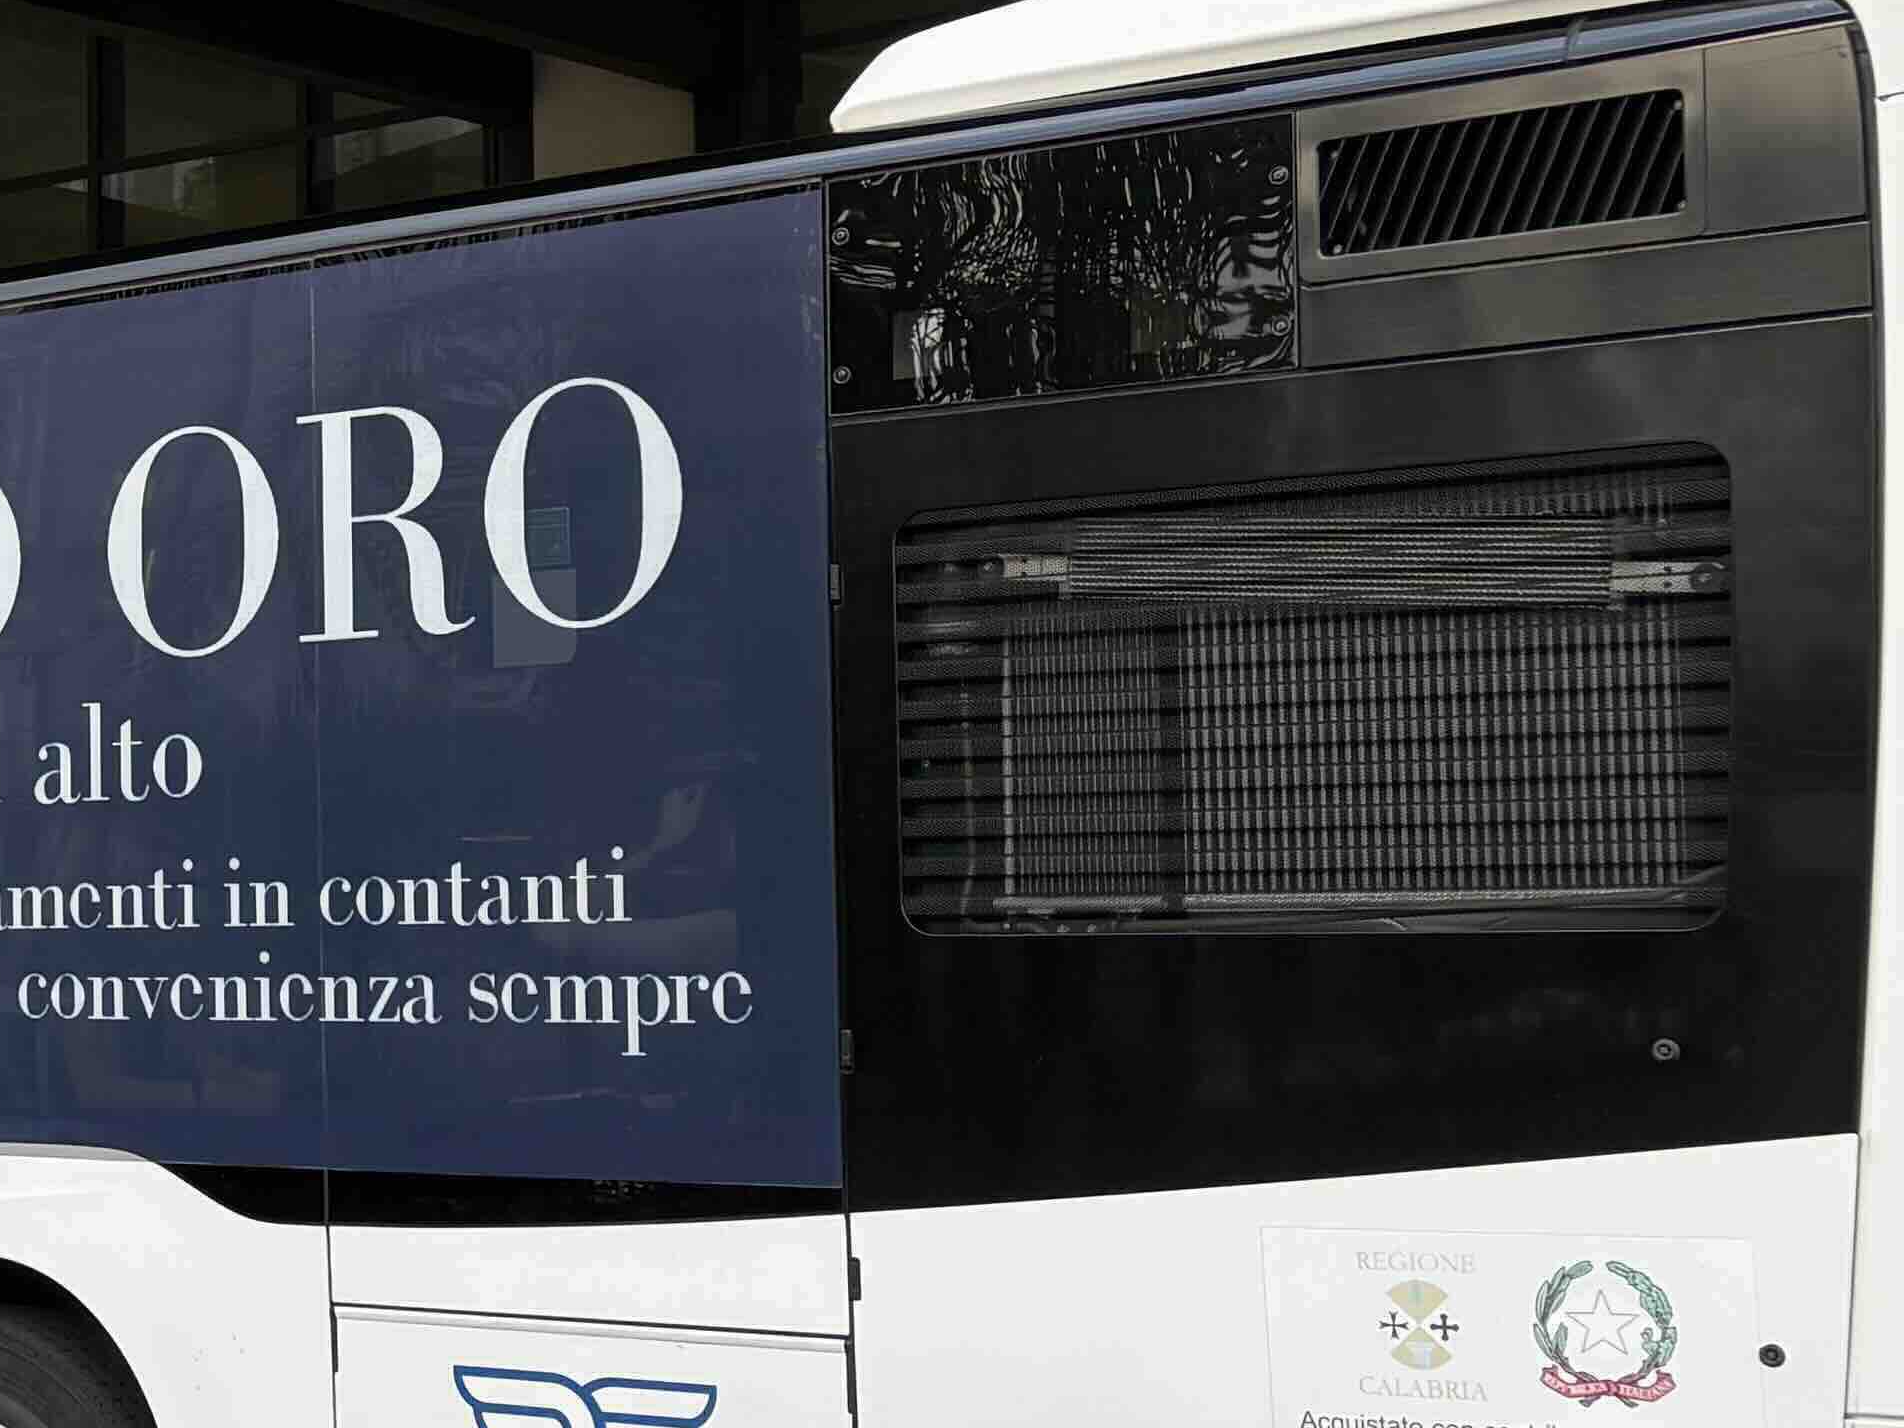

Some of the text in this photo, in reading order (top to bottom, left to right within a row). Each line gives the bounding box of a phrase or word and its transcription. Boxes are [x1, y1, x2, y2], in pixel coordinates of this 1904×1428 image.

[107, 377, 683, 658] ORO
[33, 703, 203, 805] alto
[223, 857, 295, 929] in
[320, 846, 633, 928] contanti
[17, 951, 443, 1025] convenienza
[467, 968, 753, 1057] sempre
[1356, 1251, 1476, 1275] REGIONE
[1359, 1375, 1489, 1403] CALABRIA
